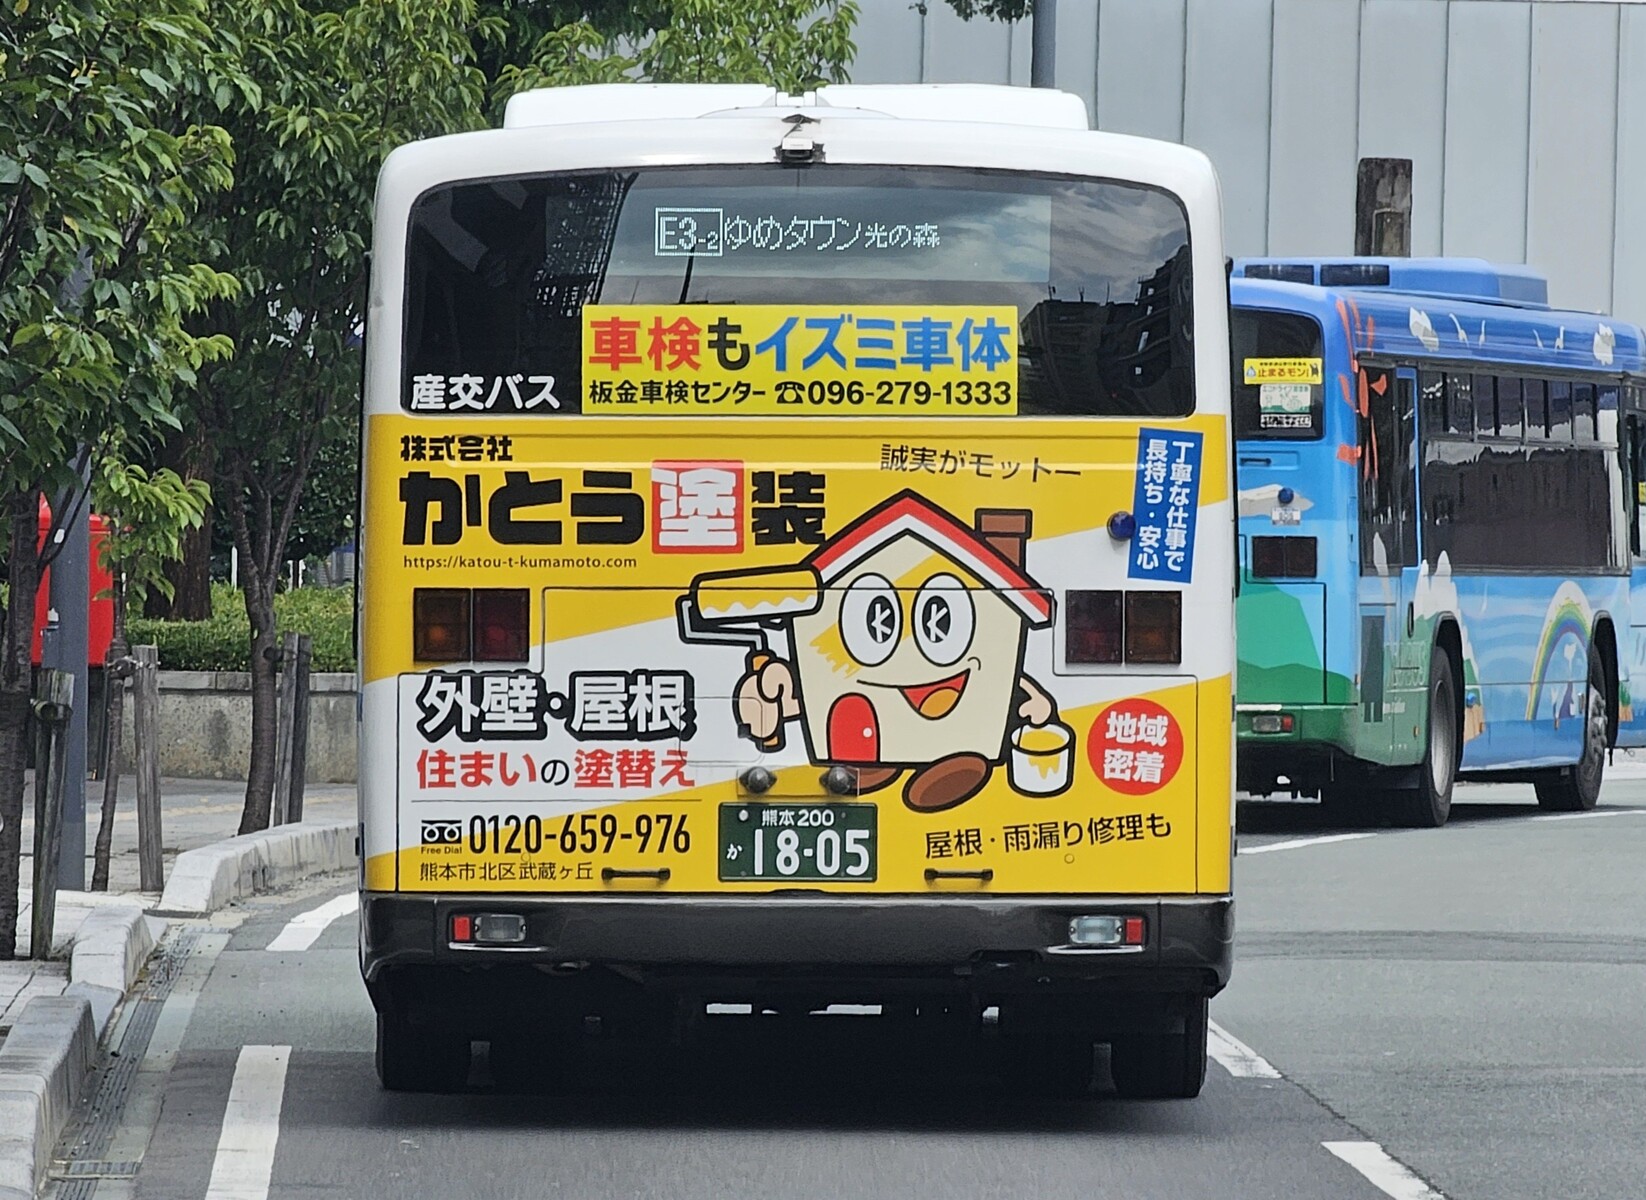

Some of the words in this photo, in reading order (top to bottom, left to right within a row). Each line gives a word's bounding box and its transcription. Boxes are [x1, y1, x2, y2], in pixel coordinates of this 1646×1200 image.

[724, 215, 940, 250] ゆめタウン光の森
[588, 313, 1012, 373] 車検もイズミ車体
[411, 374, 561, 411] 産交バス
[588, 379, 766, 405] 板金車検センター
[808, 380, 1012, 406] 096-279-1333
[400, 435, 513, 462] 株式会社
[880, 443, 1082, 483] 誠実がモットー
[399, 465, 827, 546] かとう塗装
[1136, 438, 1169, 570] 長持ち・安心
[1164, 440, 1195, 572] 丁寧な仕事で
[403, 555, 637, 570] https://katou-t-kumamoto.com
[416, 670, 697, 742] 外壁・屋根
[1105, 711, 1169, 747] 地域
[416, 749, 696, 789] 住まいの塗替え
[1103, 749, 1165, 784] 密着
[420, 846, 441, 854] Free
[444, 846, 462, 854] Dial
[469, 814, 691, 854] 0120-659-976
[726, 843, 743, 861] か
[753, 828, 870, 876] 18-05
[925, 813, 1172, 859] 屋根・雨漏り修理も
[419, 861, 593, 881] 熊本市北区武蔵ヶ丘
